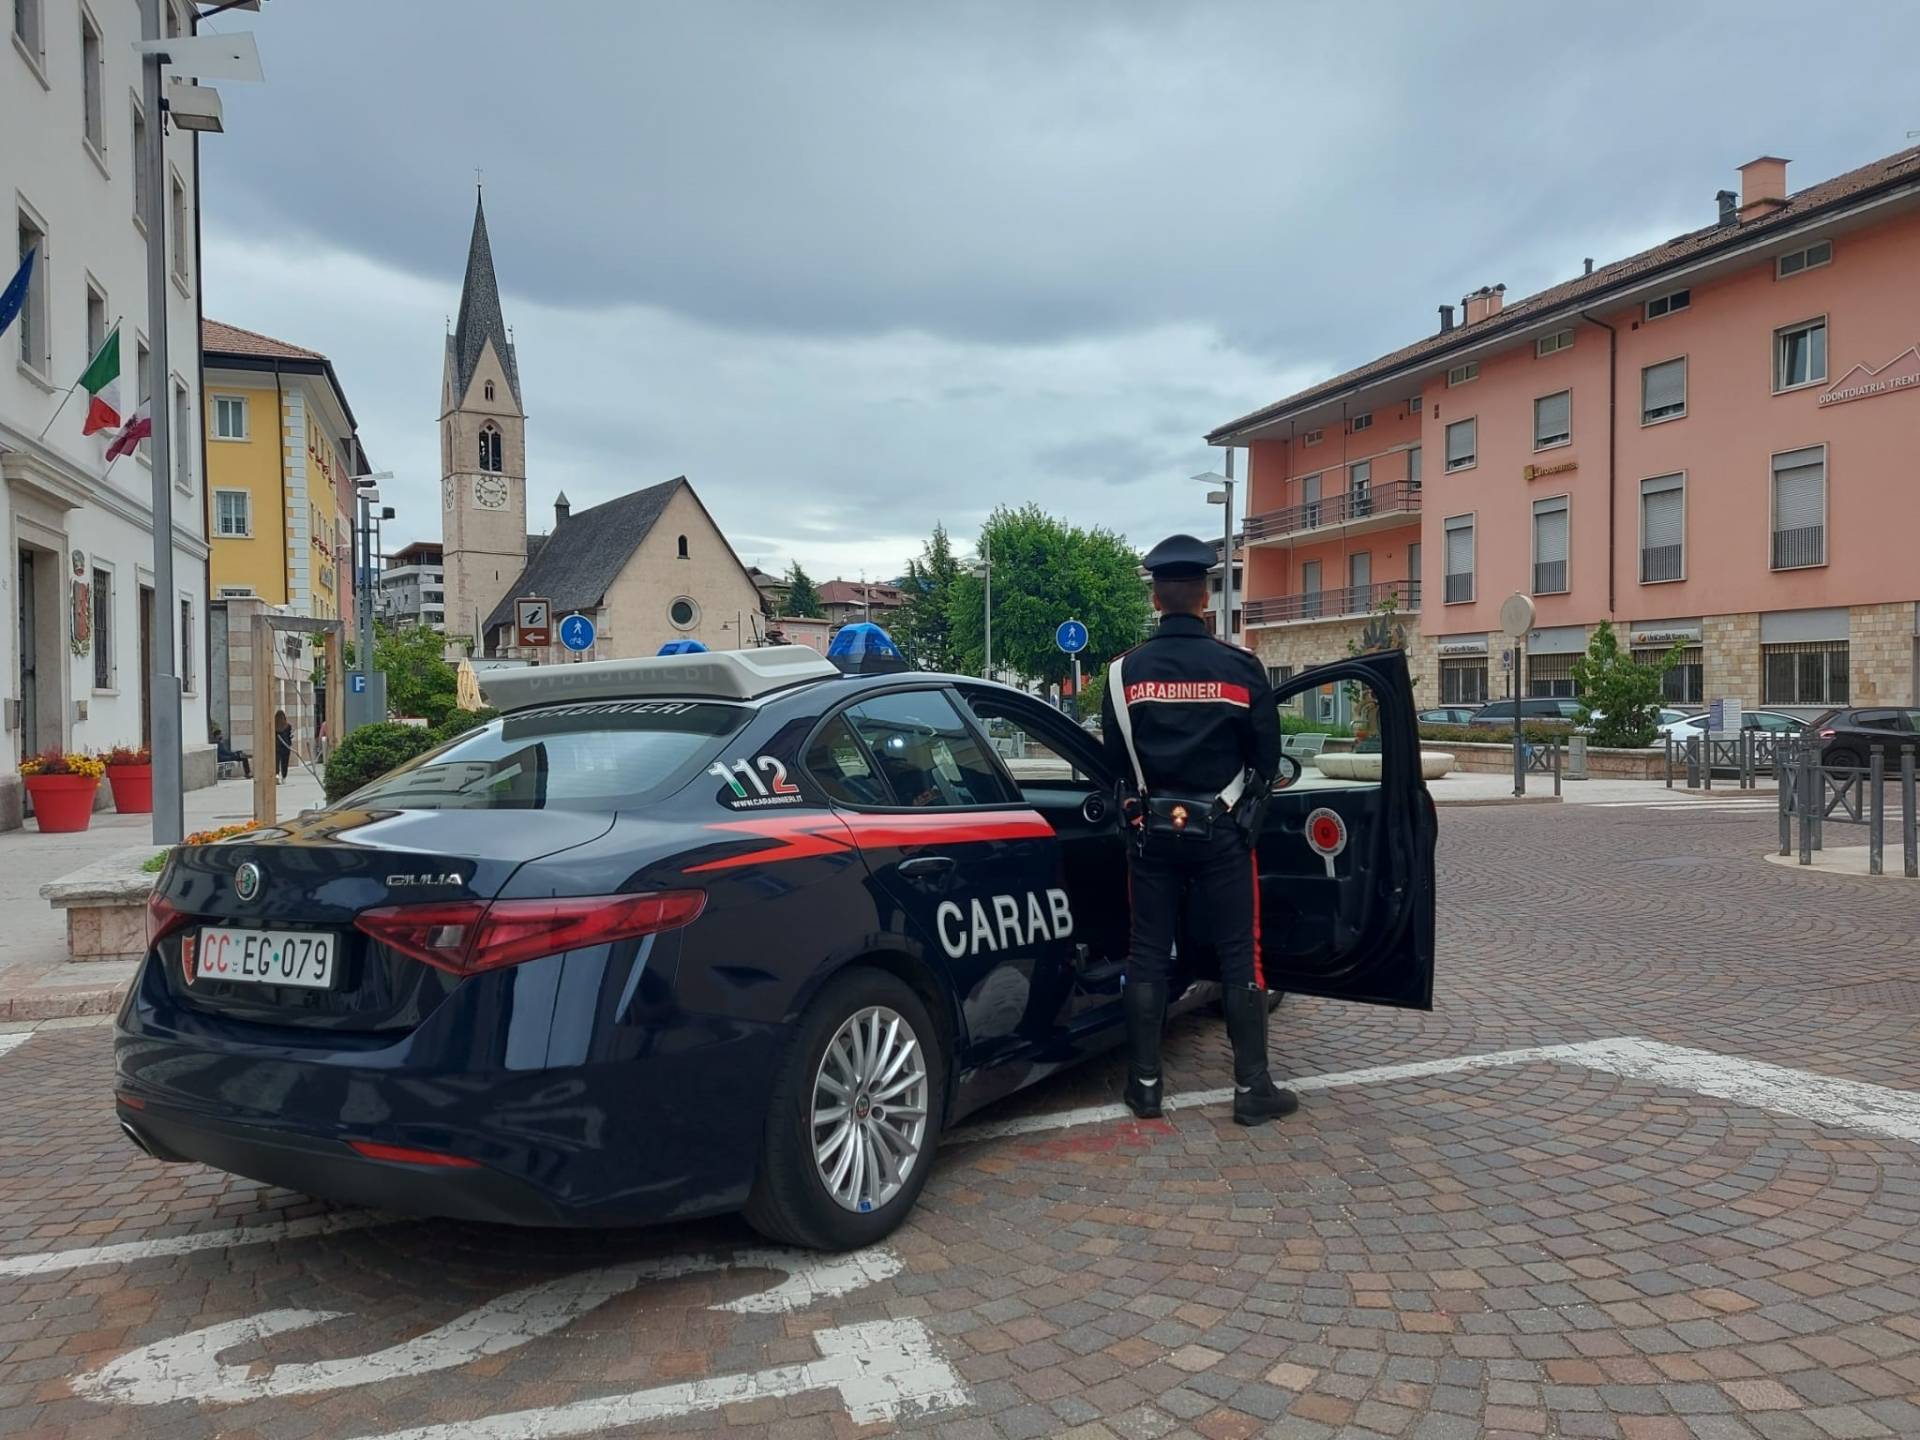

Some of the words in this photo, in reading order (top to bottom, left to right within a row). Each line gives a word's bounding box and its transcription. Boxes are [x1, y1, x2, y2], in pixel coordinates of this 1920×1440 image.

[1819, 382, 1886, 404] ODONTOIATRIA
[1130, 682, 1222, 700] CARABINIERI
[708, 755, 800, 798] 112
[386, 873, 462, 886] GIULIA
[936, 888, 1074, 959] CARAB
[203, 933, 231, 973] CC
